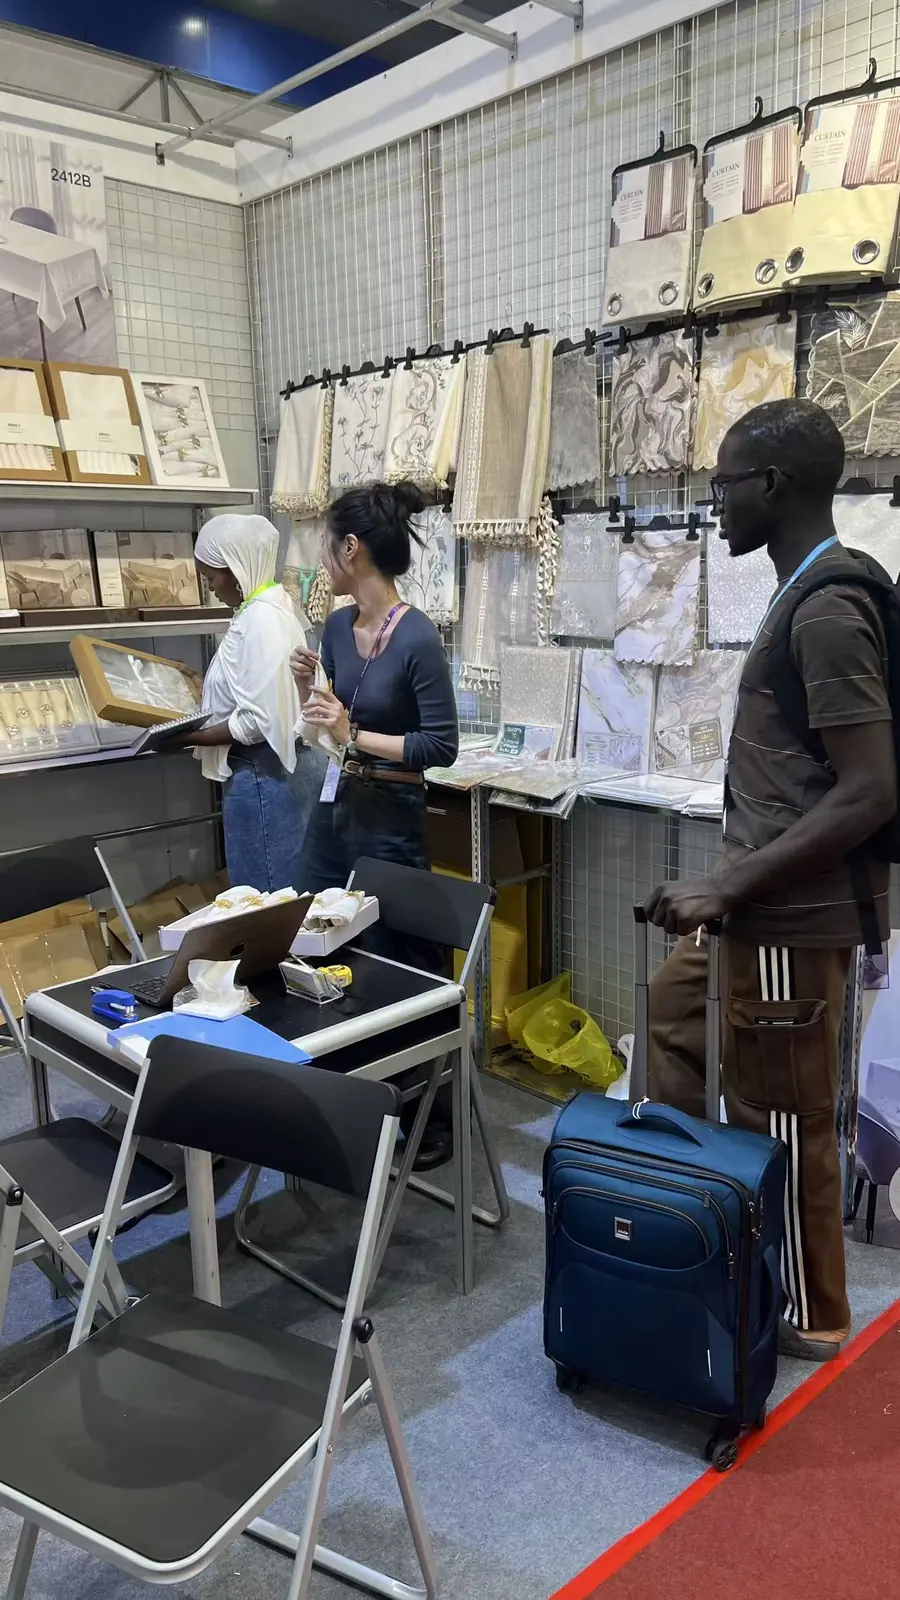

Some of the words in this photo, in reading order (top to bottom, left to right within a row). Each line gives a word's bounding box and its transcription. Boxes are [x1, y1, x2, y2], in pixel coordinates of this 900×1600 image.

[814, 129, 847, 142] CURTAIN
[51, 168, 91, 187] 2412B
[712, 162, 740, 178] CURTAIN
